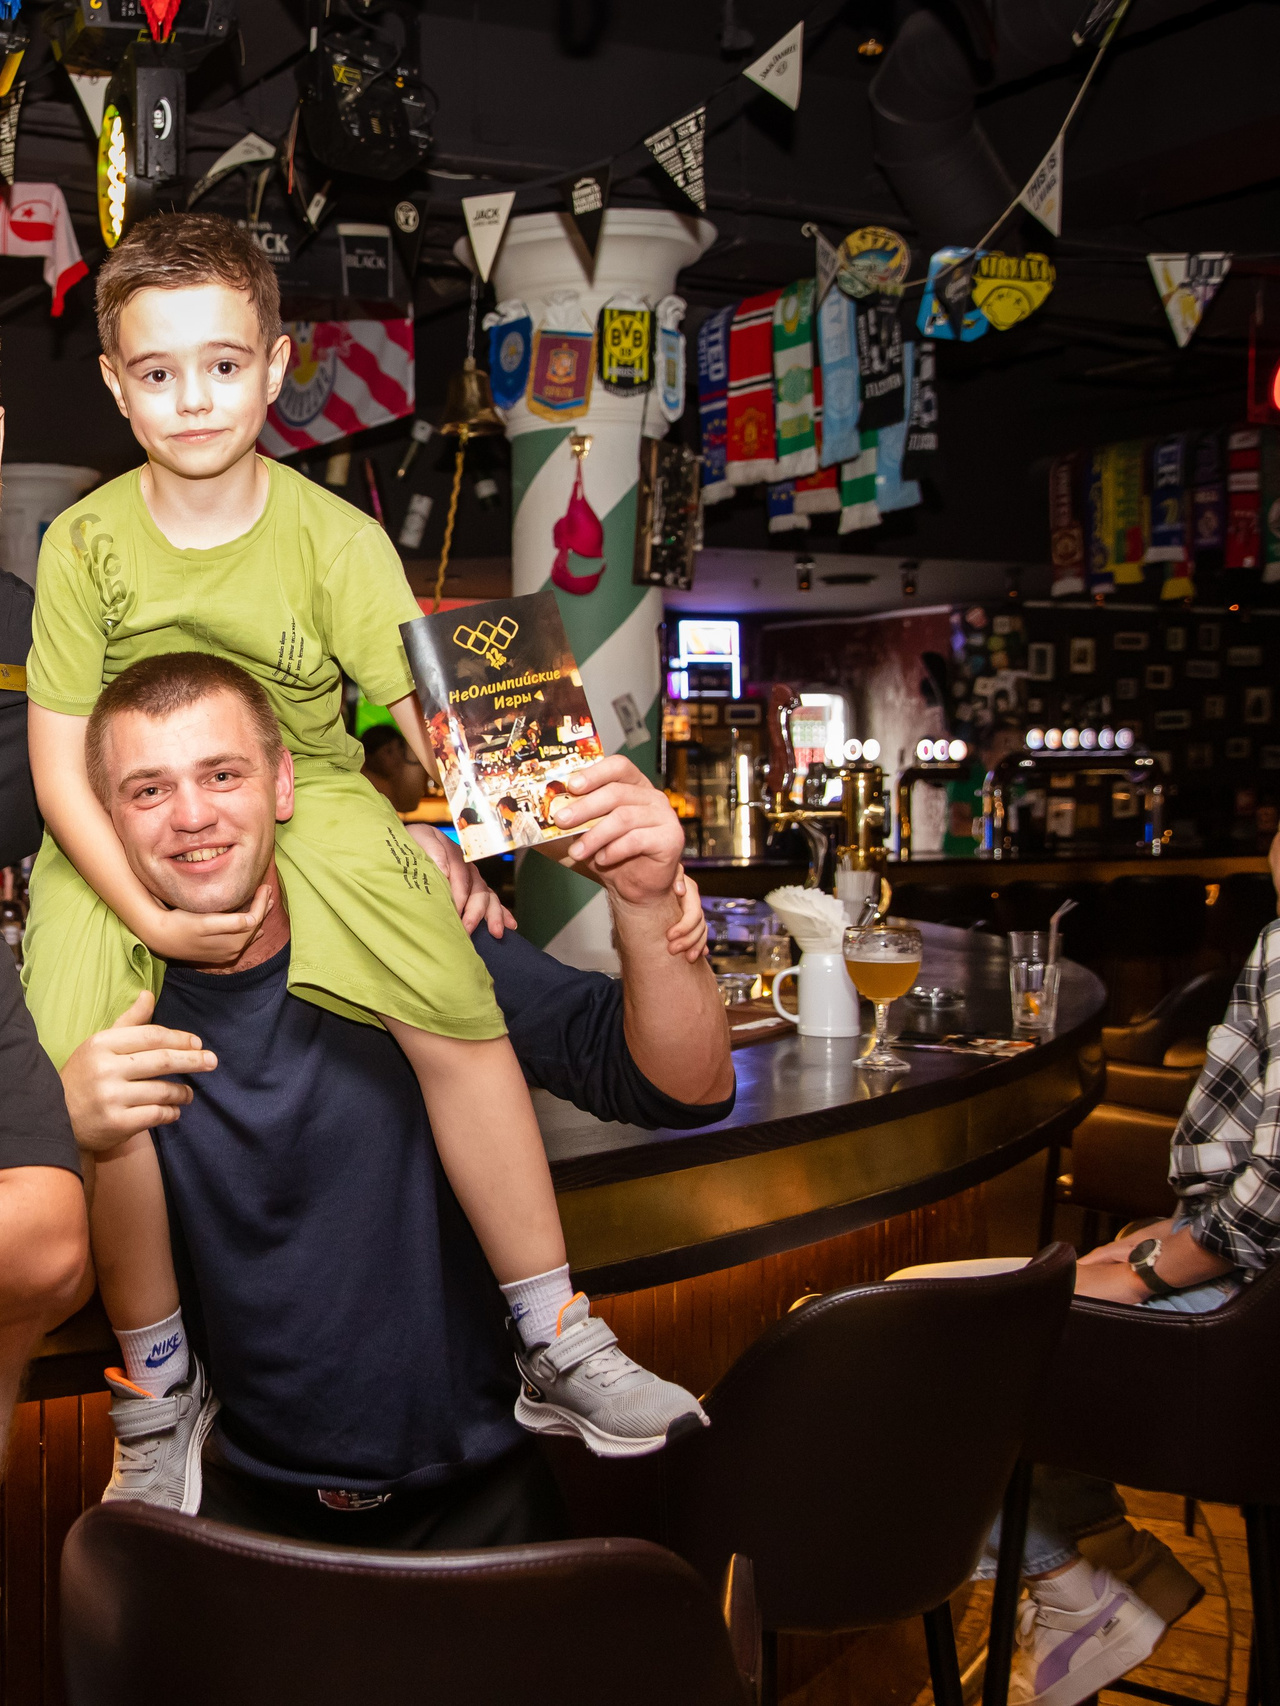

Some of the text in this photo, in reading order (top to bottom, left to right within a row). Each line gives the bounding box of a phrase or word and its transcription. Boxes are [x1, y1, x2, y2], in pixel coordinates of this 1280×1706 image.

[473, 207, 499, 221] JACK
[251, 232, 290, 255] ACK
[345, 254, 387, 270] BLACK
[611, 319, 643, 349] BVB
[449, 669, 561, 704] НеОлимпийские
[494, 692, 532, 710] Игры
[151, 1332, 179, 1357] NIKE
